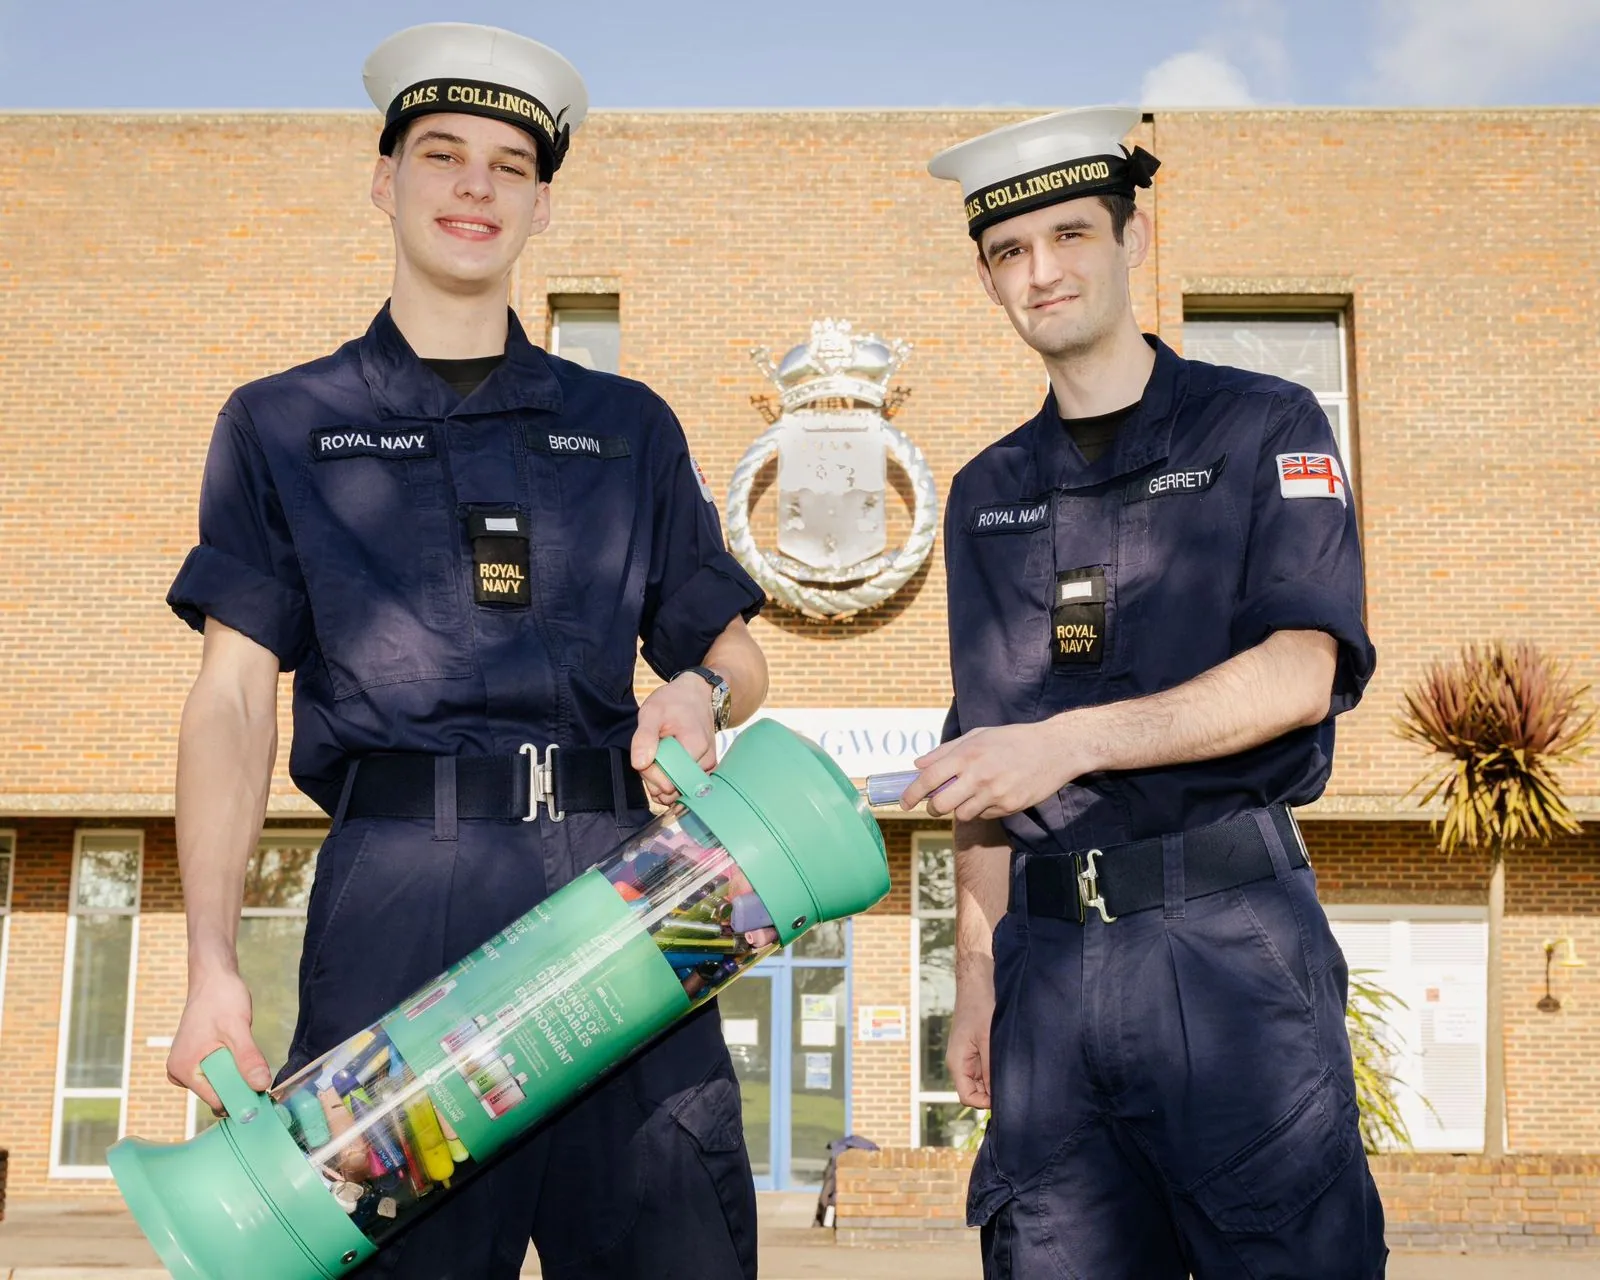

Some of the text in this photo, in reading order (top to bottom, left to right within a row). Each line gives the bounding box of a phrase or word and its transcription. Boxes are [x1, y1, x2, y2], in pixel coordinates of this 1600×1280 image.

[400, 85, 555, 142] H.M.S. COLLINGWOO
[985, 161, 1110, 210] COLLINGWOOD
[320, 433, 425, 451] ROYAL NAVY
[548, 434, 601, 453] BROWN
[1148, 468, 1213, 494] GERRETY
[978, 504, 1047, 527] ROYAL NAVY
[479, 563, 525, 594] ROYAL NAVY
[1056, 624, 1097, 654] ROYAL NAVY
[513, 983, 574, 1067] ENRONMENT
[536, 969, 592, 1048] DIOSABLES
[542, 1004, 573, 1045] BETTER
[560, 985, 590, 1022] KINDS
[584, 1019, 601, 1037] OF
[584, 998, 611, 1034] RECYCLE
